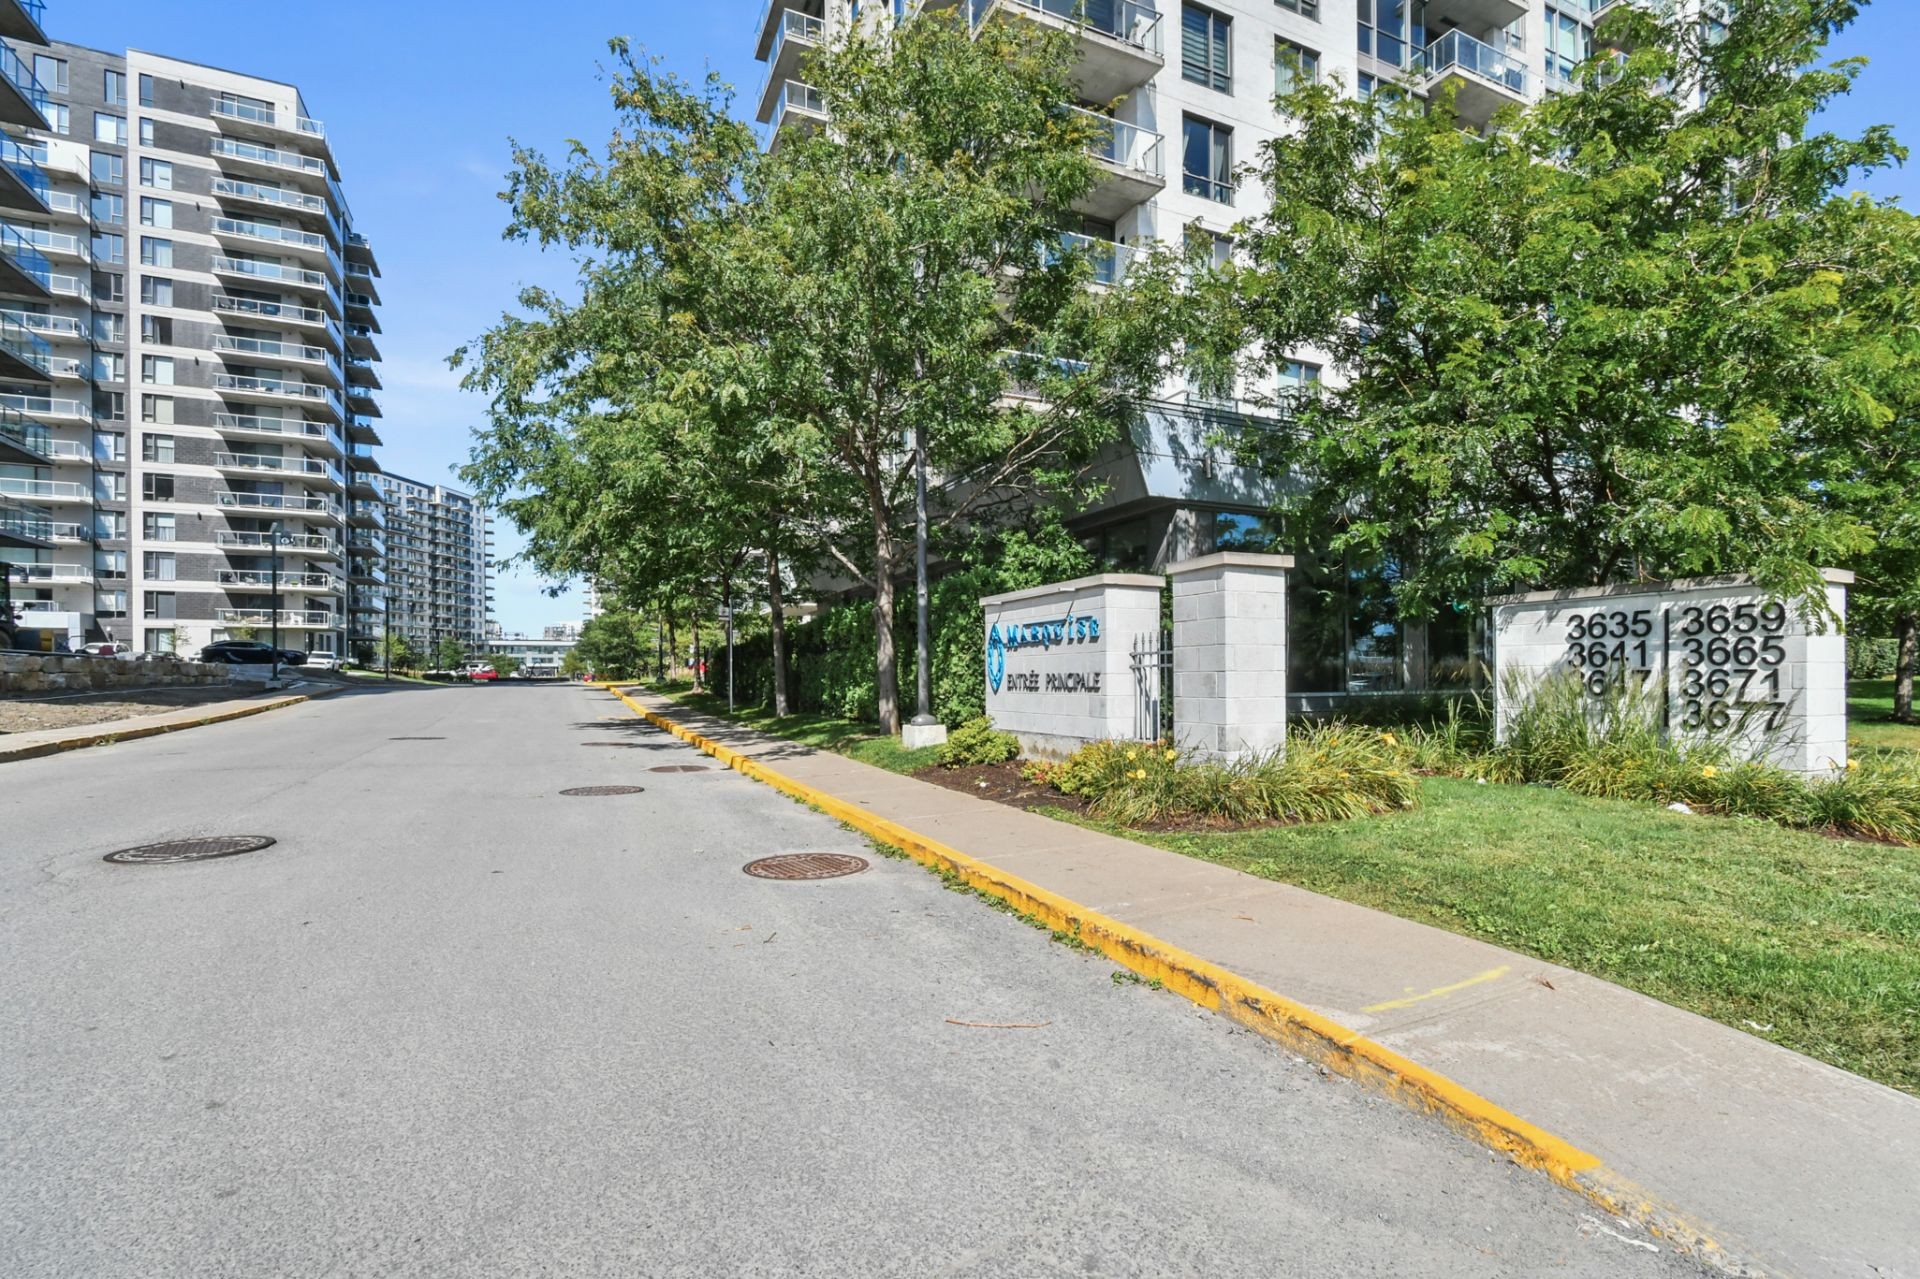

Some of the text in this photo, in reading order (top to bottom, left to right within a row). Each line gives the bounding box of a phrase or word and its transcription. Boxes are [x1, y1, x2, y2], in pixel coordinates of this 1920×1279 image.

[1567, 610, 1652, 640] 3635
[1682, 602, 1786, 635] 3659
[1568, 640, 1647, 668] 3641
[1682, 635, 1786, 667] 3665
[1007, 670, 1101, 693] ENTRÉE PRINCIPALE
[1682, 668, 1779, 699] 3671
[1682, 699, 1786, 732] 3677
